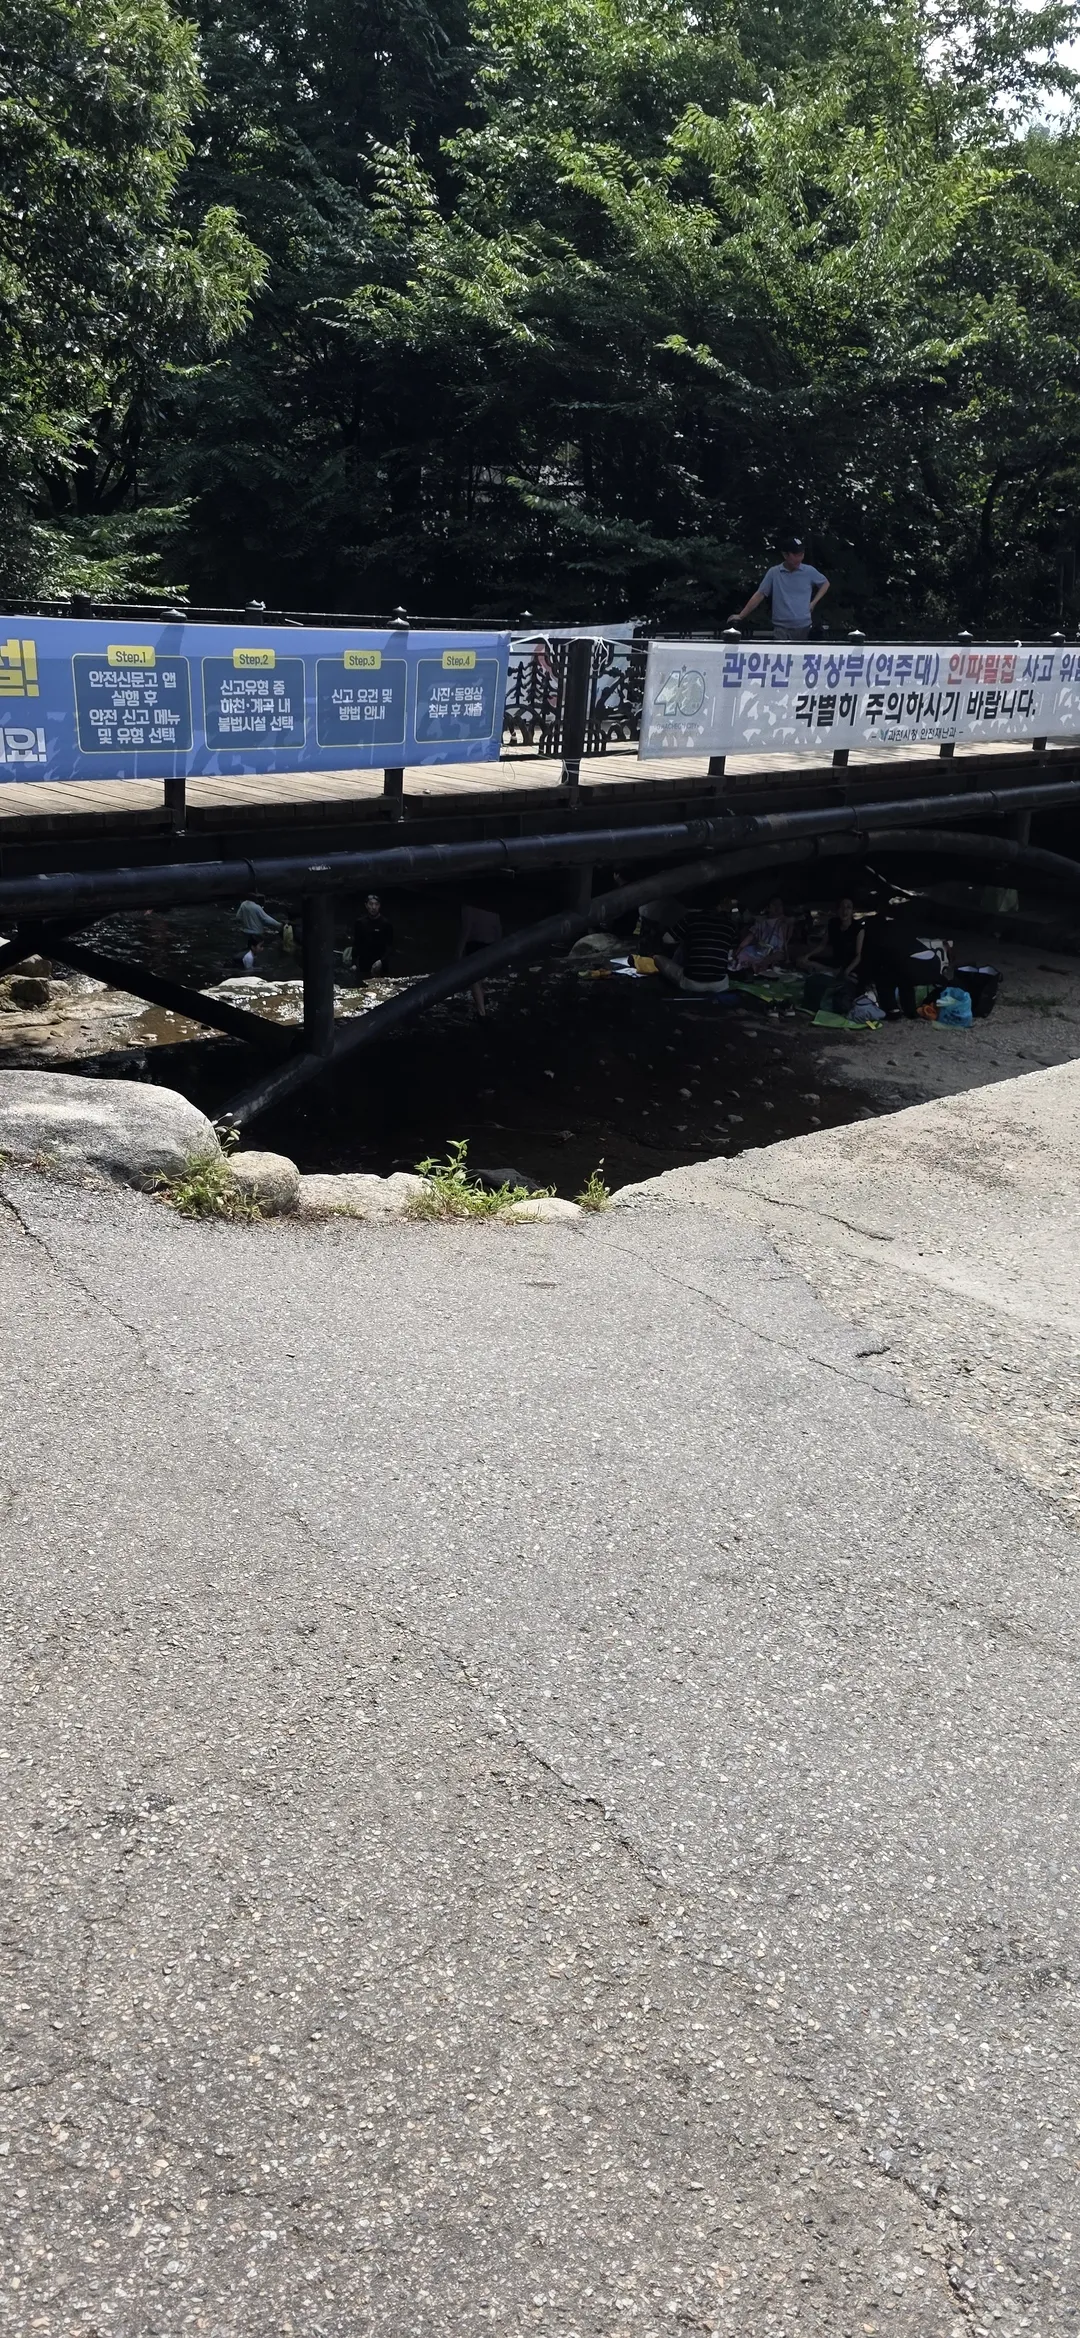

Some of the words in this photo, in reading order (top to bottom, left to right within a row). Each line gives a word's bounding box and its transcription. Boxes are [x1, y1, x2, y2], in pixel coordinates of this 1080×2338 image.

[116, 651, 146, 663] Step.1
[239, 654, 269, 665] Step.2
[349, 655, 376, 666] Step.3
[446, 656, 470, 666] Step.4
[722, 653, 793, 687] 관악산
[802, 653, 939, 688] 정상부(연주대)
[947, 653, 1017, 684] 인파밀집
[1022, 655, 1055, 682] 사고
[89, 671, 158, 688] 안전신문고
[163, 673, 176, 688] 앱
[220, 680, 269, 696] 신고유형
[273, 680, 285, 696] 중
[430, 686, 483, 702] 사진·동영상
[112, 690, 139, 706] 실행
[144, 691, 158, 706] 후
[332, 689, 353, 703] 신고
[358, 689, 379, 703] 요건
[383, 690, 392, 703] 및
[221, 698, 274, 713] 하천·계곡
[279, 698, 290, 713] 내
[339, 706, 360, 720] 방법
[365, 706, 385, 720] 안내
[429, 703, 448, 718] 첨부
[451, 703, 460, 717] 후
[464, 703, 482, 717] 제출
[795, 693, 857, 727] 각별히
[865, 691, 960, 724] 주의하시기
[967, 690, 1036, 720] 바랍니다.
[90, 710, 117, 725] 안전
[123, 710, 149, 724] 신고
[154, 710, 180, 724] 메뉴
[218, 716, 266, 732] 불법시설
[270, 716, 293, 731] 선택
[98, 730, 112, 744] 및
[117, 729, 144, 743] 유형
[149, 729, 175, 743] 선택
[888, 729, 918, 741] 과천시청
[920, 727, 956, 739] 안전재난과
[0, 727, 47, 763] 요!
